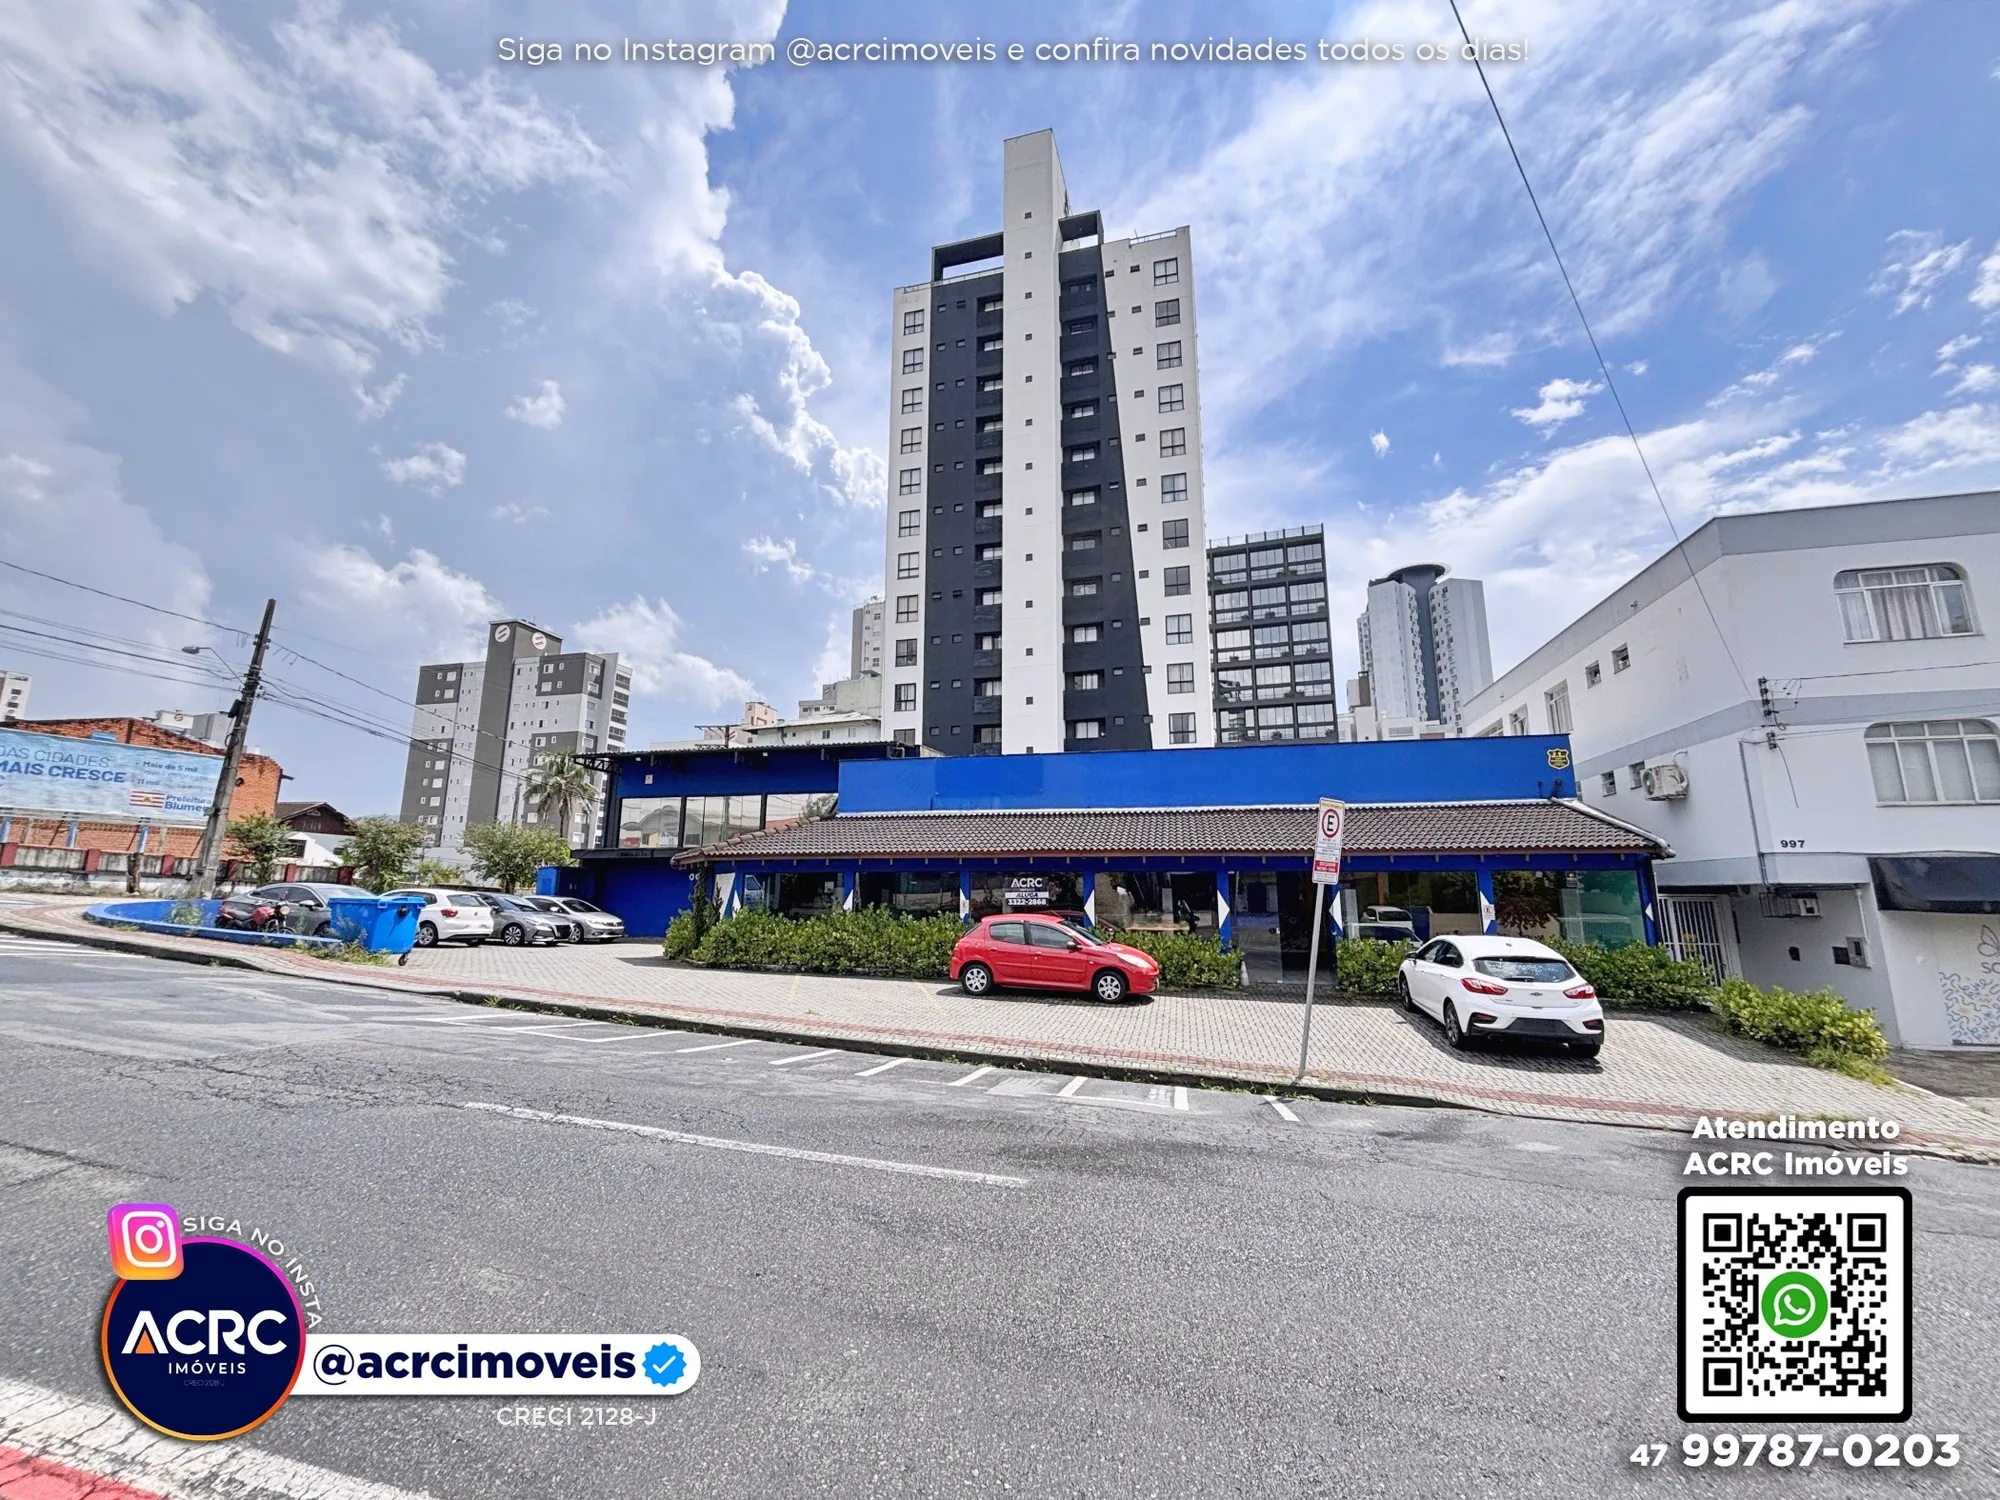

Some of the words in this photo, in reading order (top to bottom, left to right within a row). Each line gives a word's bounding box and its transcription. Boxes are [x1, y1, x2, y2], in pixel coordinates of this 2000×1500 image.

[35, 750, 110, 767] CIDADES
[48, 766, 126, 783] CRESCE
[166, 794, 212, 804] Prefeitura
[1327, 815, 1334, 831] E
[1780, 840, 1805, 848] 997
[1011, 878, 1042, 887] ACRC
